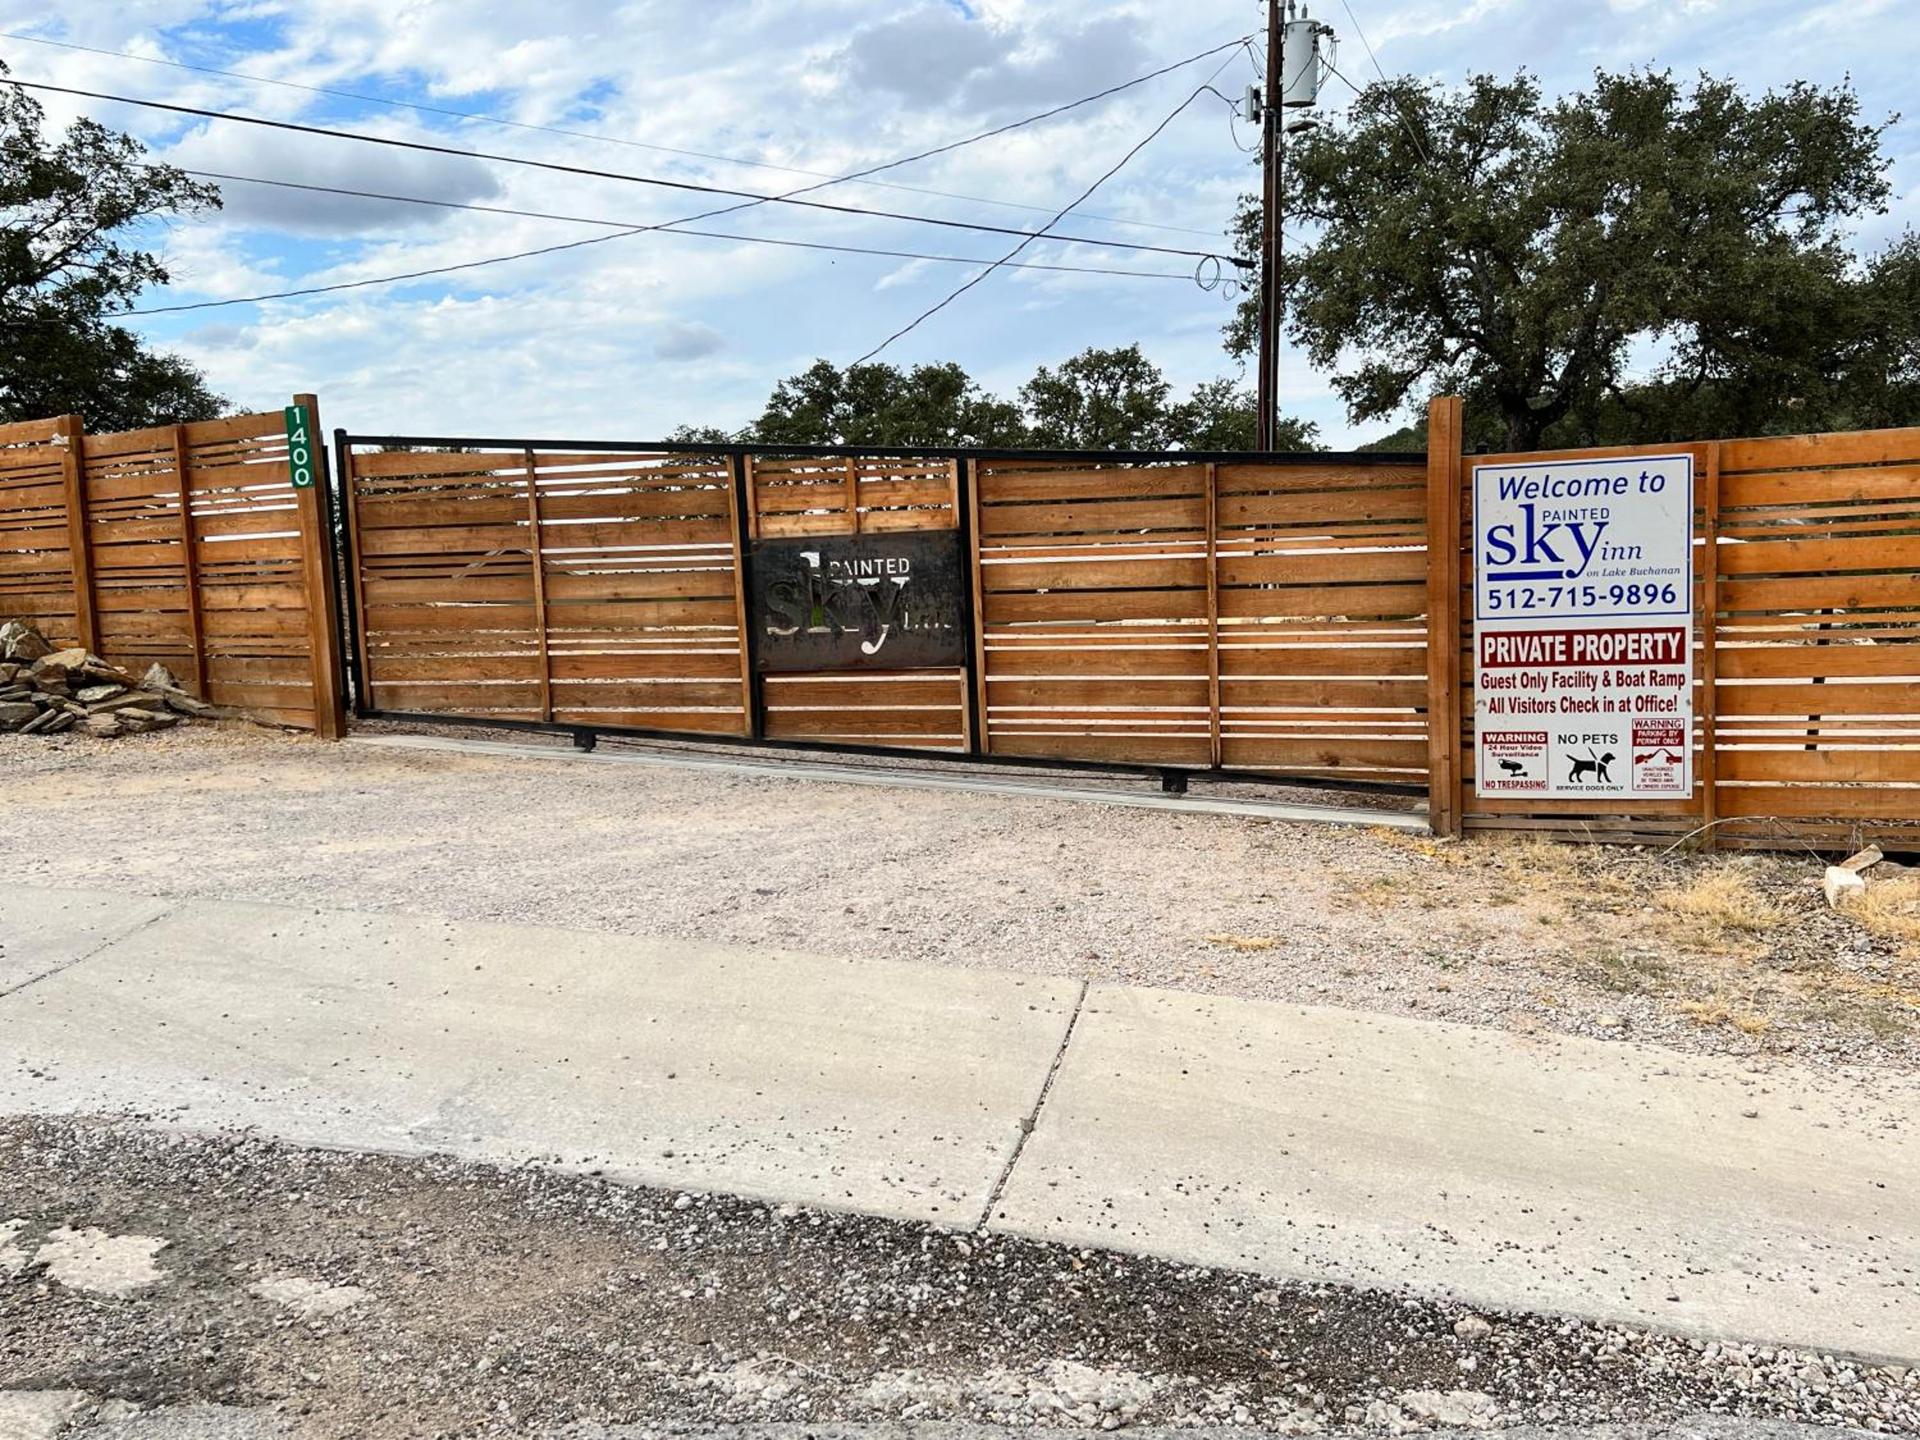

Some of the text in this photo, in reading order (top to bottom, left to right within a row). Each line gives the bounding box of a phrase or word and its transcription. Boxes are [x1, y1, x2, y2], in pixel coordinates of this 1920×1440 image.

[291, 407, 310, 486] 1400
[1499, 471, 1666, 501] Welcome to
[1542, 508, 1610, 522] PAINTED
[1486, 503, 1643, 579] sky inn
[829, 558, 910, 576] PAINTED
[1602, 568, 1627, 577] Lake
[1629, 567, 1681, 576] Buchanan
[1488, 583, 1677, 609] 512-715-9896
[1484, 632, 1682, 663] PRIVATE PROPERTY
[1481, 669, 1686, 692] Guest Only Facility & Boat Ramp
[1488, 694, 1678, 713] All Visitors Check in at Office!
[1635, 719, 1682, 728] WARNING
[1486, 733, 1546, 742] WARNING
[1558, 734, 1618, 744] NO PETS
[1485, 780, 1546, 789] NO TRESPASSING
